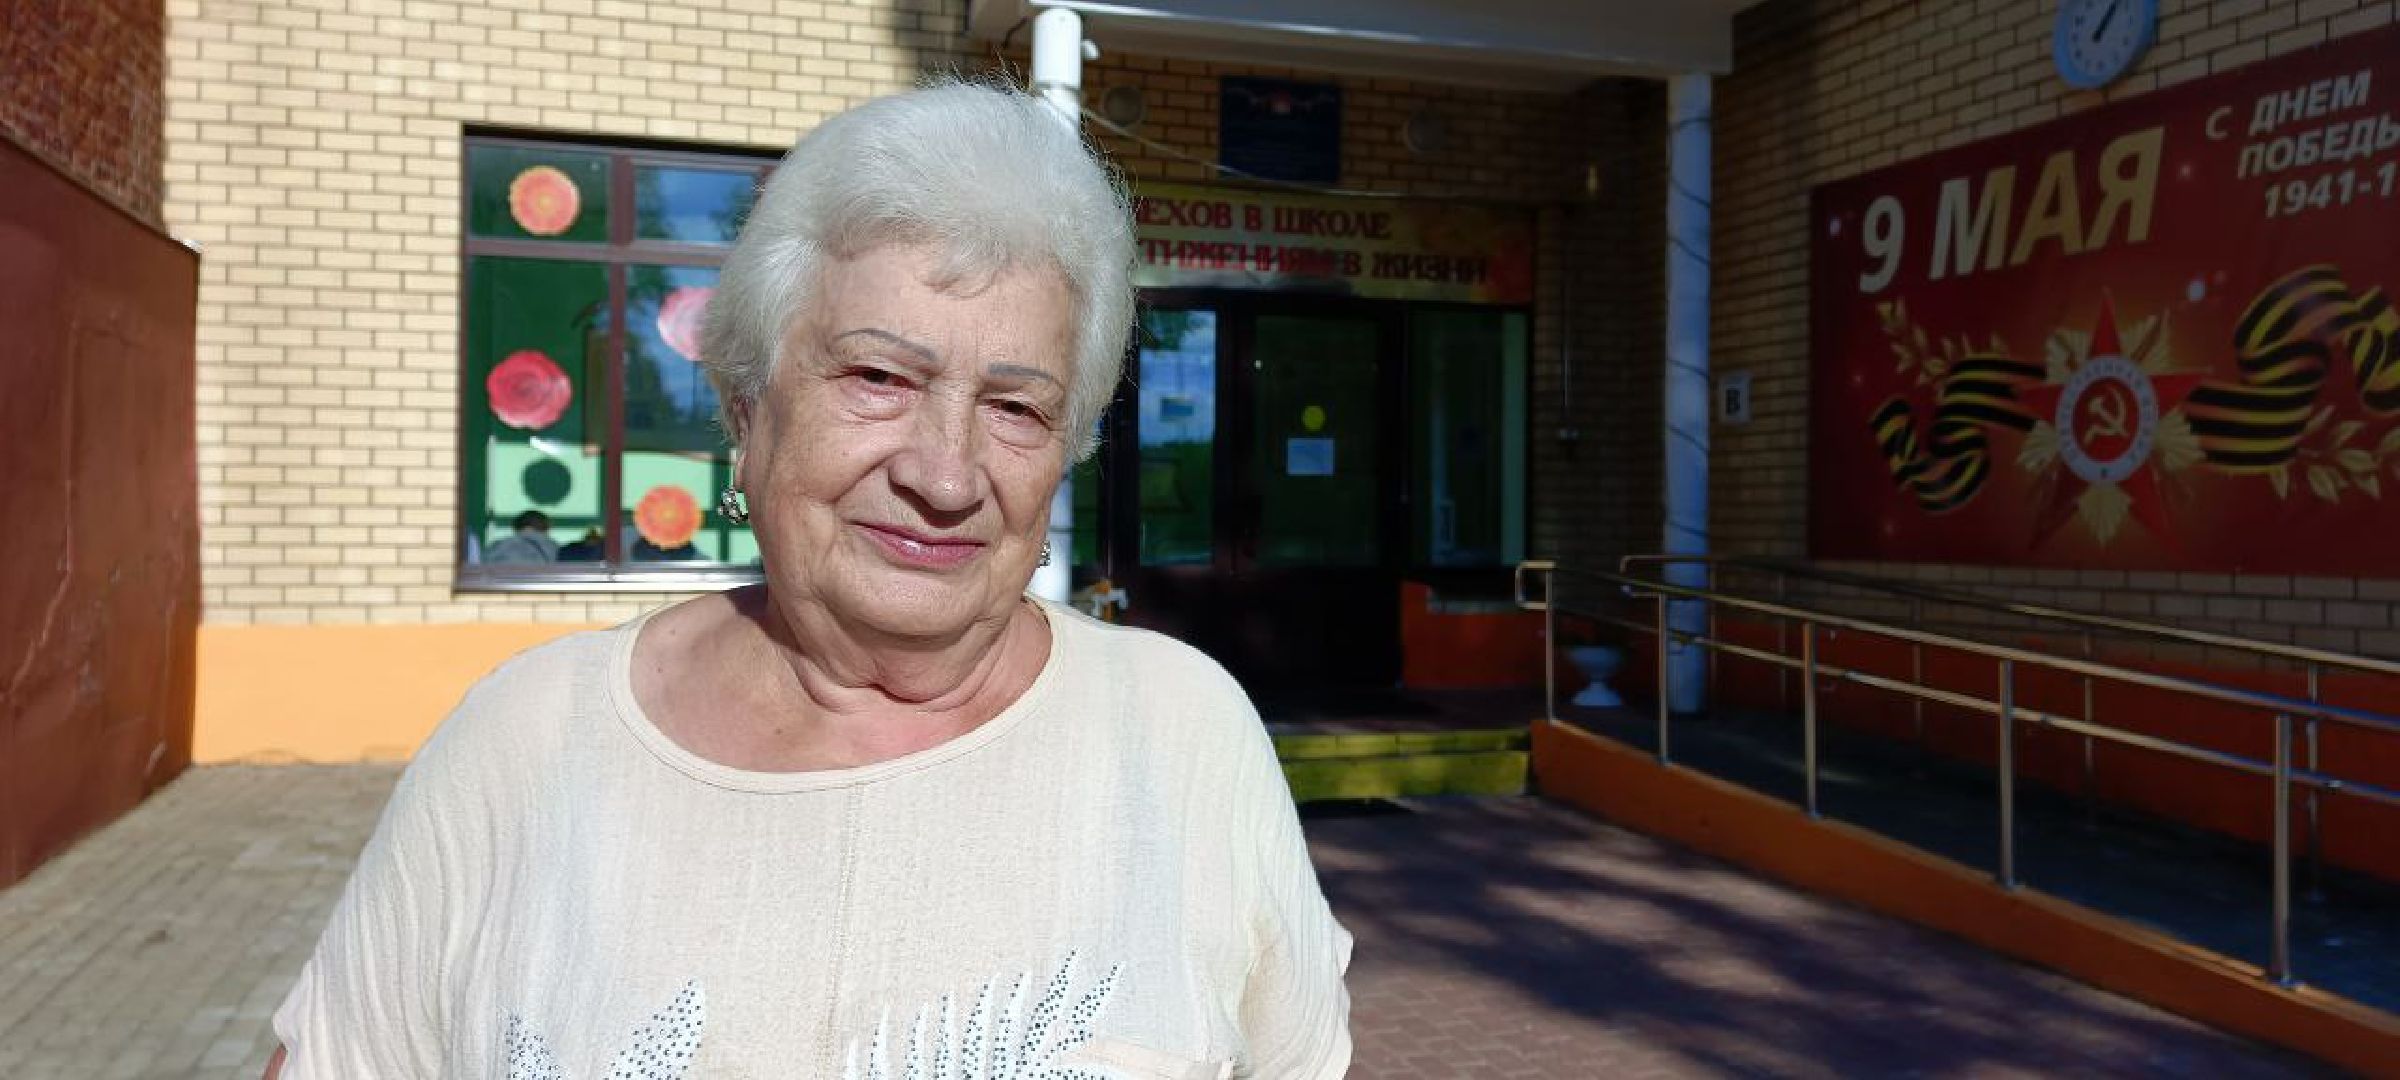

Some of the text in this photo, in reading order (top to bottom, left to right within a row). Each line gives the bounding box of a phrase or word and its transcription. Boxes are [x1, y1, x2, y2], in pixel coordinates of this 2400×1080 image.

[2205, 67, 2372, 140] С ДНЕМ
[1245, 205, 1260, 231] В
[1275, 206, 1391, 240] ШКОЛЕ
[1859, 126, 2165, 294] 9 МАЯ
[1344, 250, 1361, 277] В
[1372, 251, 1488, 286] ЖИЗНИ
